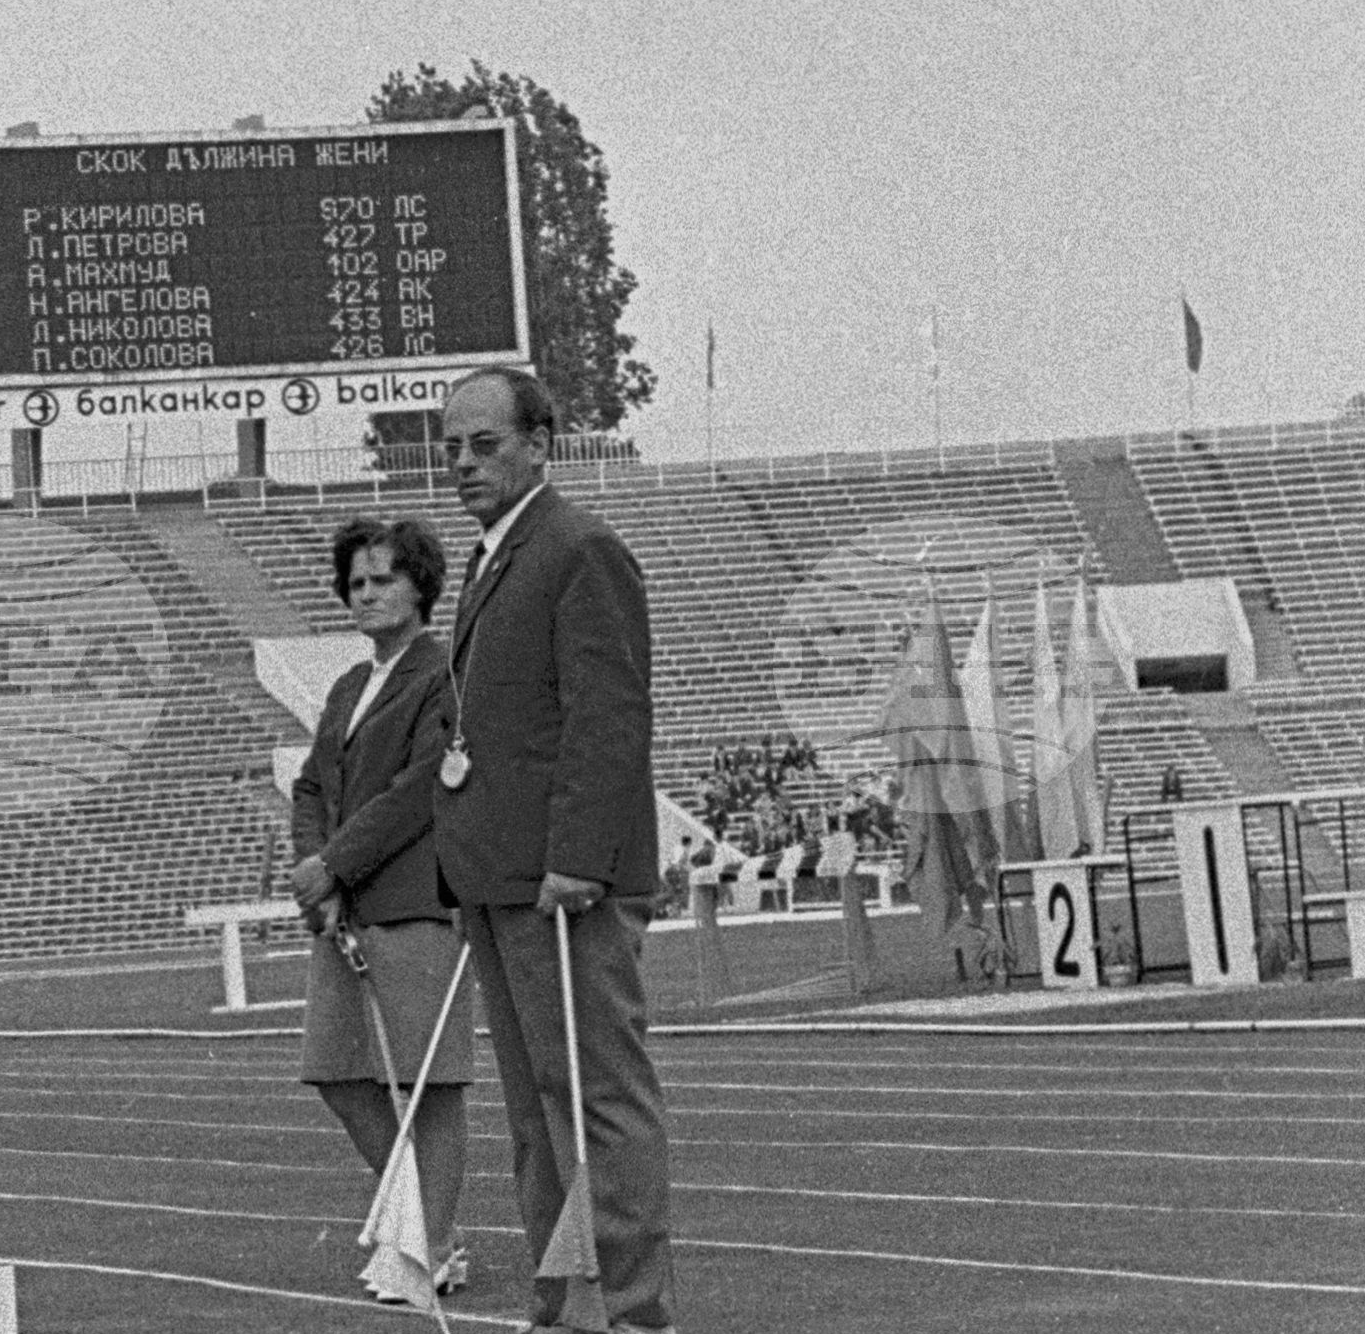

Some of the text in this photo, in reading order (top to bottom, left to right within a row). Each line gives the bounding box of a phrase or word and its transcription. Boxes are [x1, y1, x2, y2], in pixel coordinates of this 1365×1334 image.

[76, 140, 389, 173] СКОК ДЪЛЖИНА ЖЕНИ
[23, 203, 205, 233] Р.КИРИЛОВА
[323, 224, 375, 248] 427
[394, 222, 428, 245] ТР
[28, 249, 447, 288] А.МАХМУД 102 ОАР
[29, 276, 432, 315] Н.АНГЕЛОВА 424 АК
[329, 306, 382, 331] 433
[330, 334, 384, 358] 426
[76, 383, 266, 418] балканкар
[1204, 825, 1229, 976] 1
[1047, 882, 1081, 978] 2
